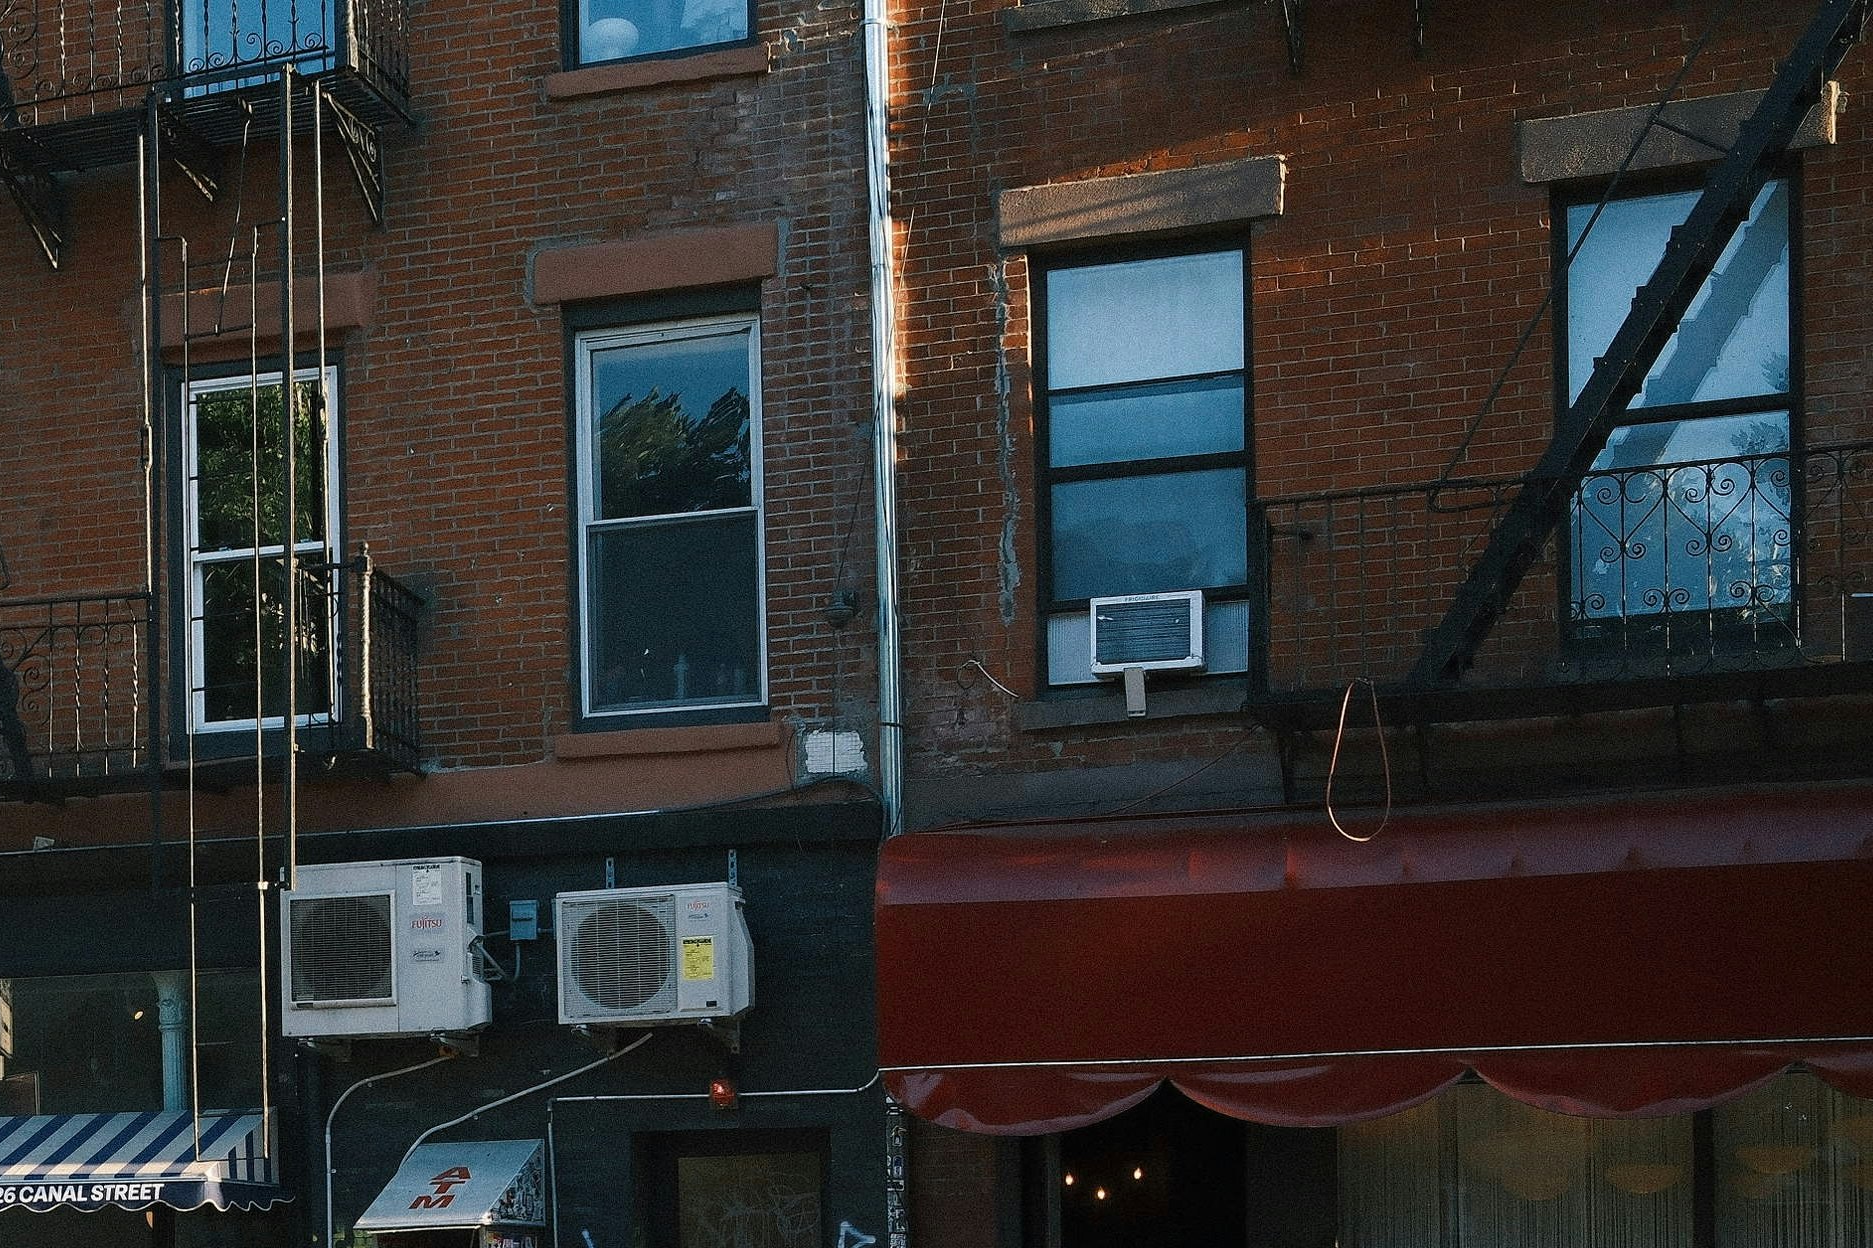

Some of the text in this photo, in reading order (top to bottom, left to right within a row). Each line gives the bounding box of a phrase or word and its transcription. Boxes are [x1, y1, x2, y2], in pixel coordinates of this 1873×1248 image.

[411, 918, 442, 930] FUJITSU
[19, 1185, 87, 1203] CANAL
[91, 1183, 165, 1201] STREET
[408, 1166, 472, 1210] ATM
